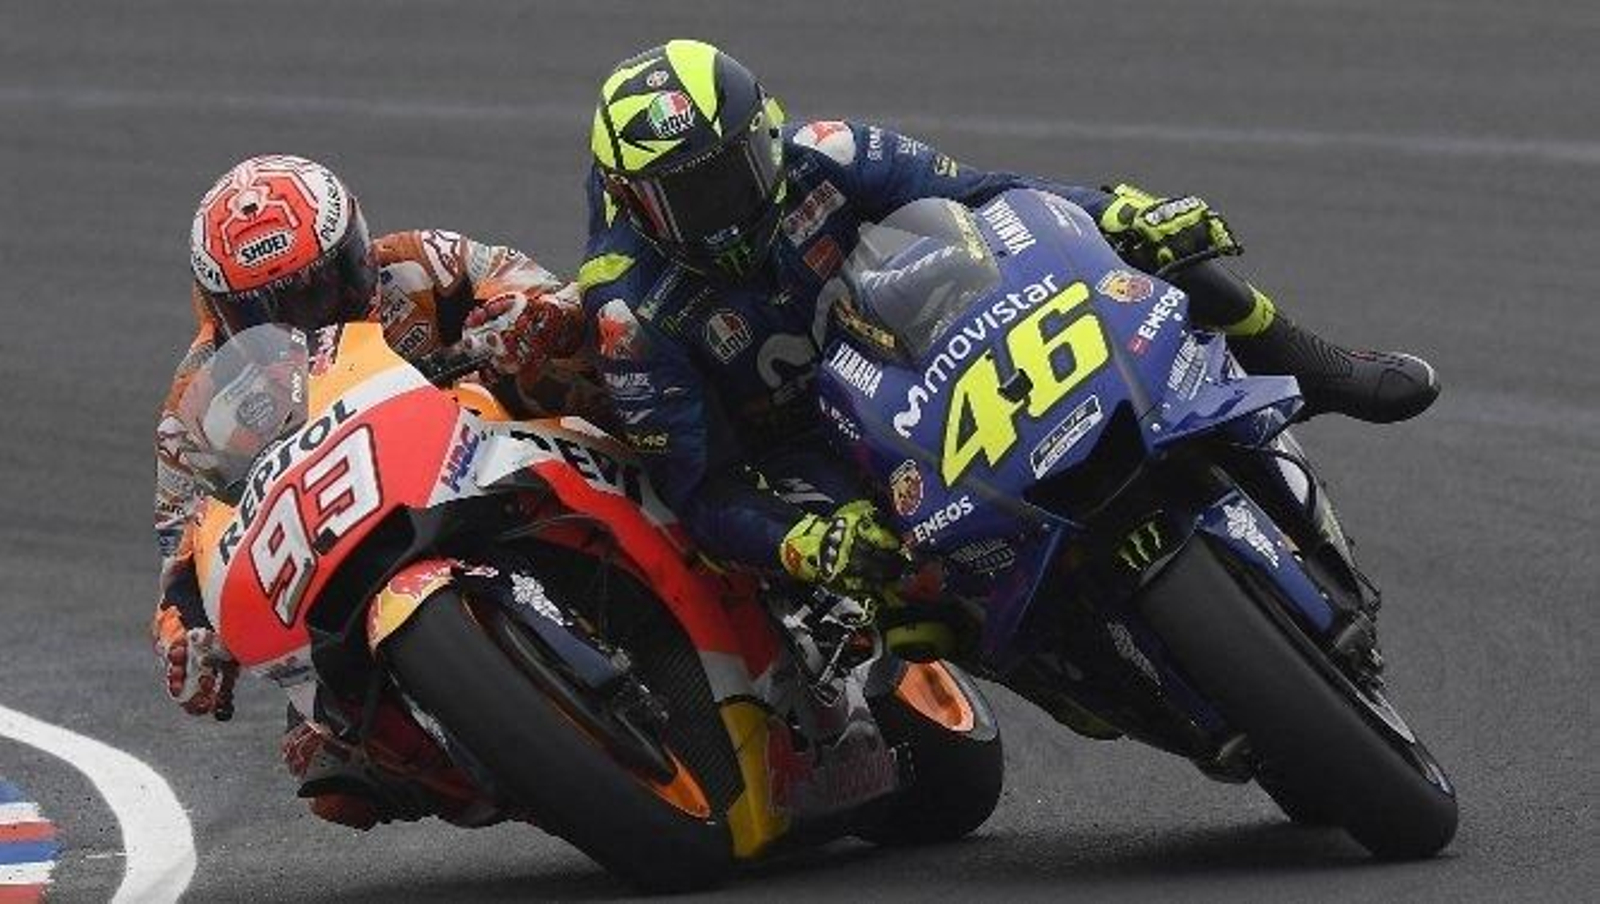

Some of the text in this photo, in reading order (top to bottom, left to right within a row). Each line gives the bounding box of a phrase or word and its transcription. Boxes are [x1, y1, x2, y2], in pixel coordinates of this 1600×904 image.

[241, 234, 287, 260] SHOEI
[924, 273, 1061, 394] movistar
[1138, 287, 1185, 339] ENEOS
[828, 342, 884, 399] YAMAHA
[942, 281, 1109, 487] 46
[219, 400, 357, 566] REPSOL
[249, 423, 383, 629] 93
[913, 495, 975, 544] ENEOS
